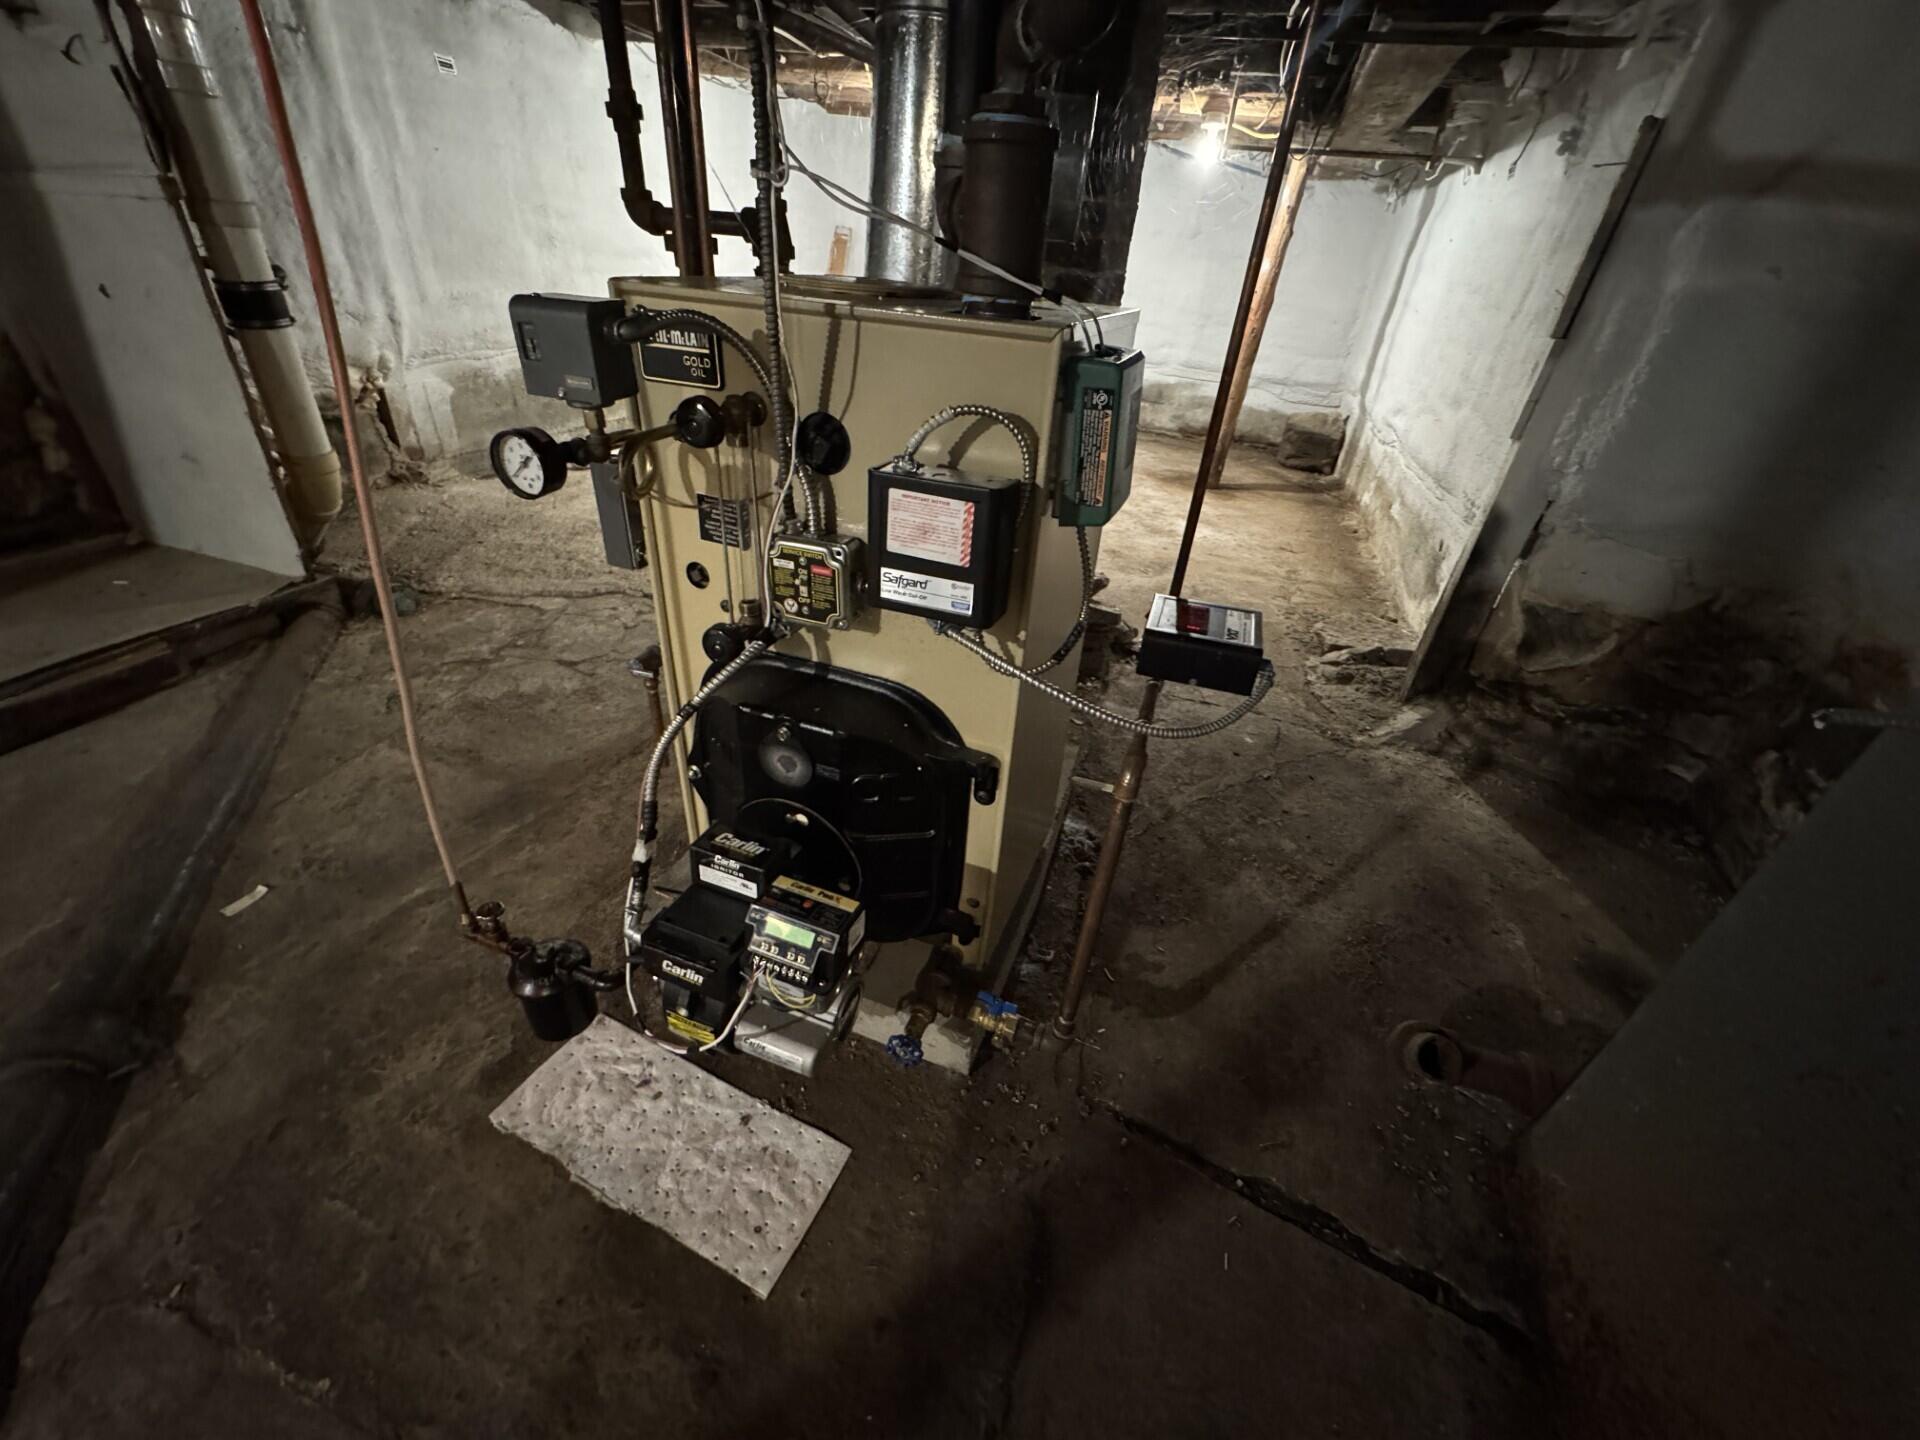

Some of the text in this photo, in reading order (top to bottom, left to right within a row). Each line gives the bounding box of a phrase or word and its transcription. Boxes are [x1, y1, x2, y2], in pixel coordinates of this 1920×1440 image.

[682, 355, 711, 369] GOLD
[690, 367, 707, 378] OIL
[882, 571, 928, 590] Safgard
[798, 596, 810, 605] OFF
[714, 832, 766, 855] Carlin
[714, 854, 740, 870] Carlin
[710, 863, 744, 878] IGNITOR
[661, 959, 704, 985] Carlin
[743, 1037, 766, 1051] Carlin
